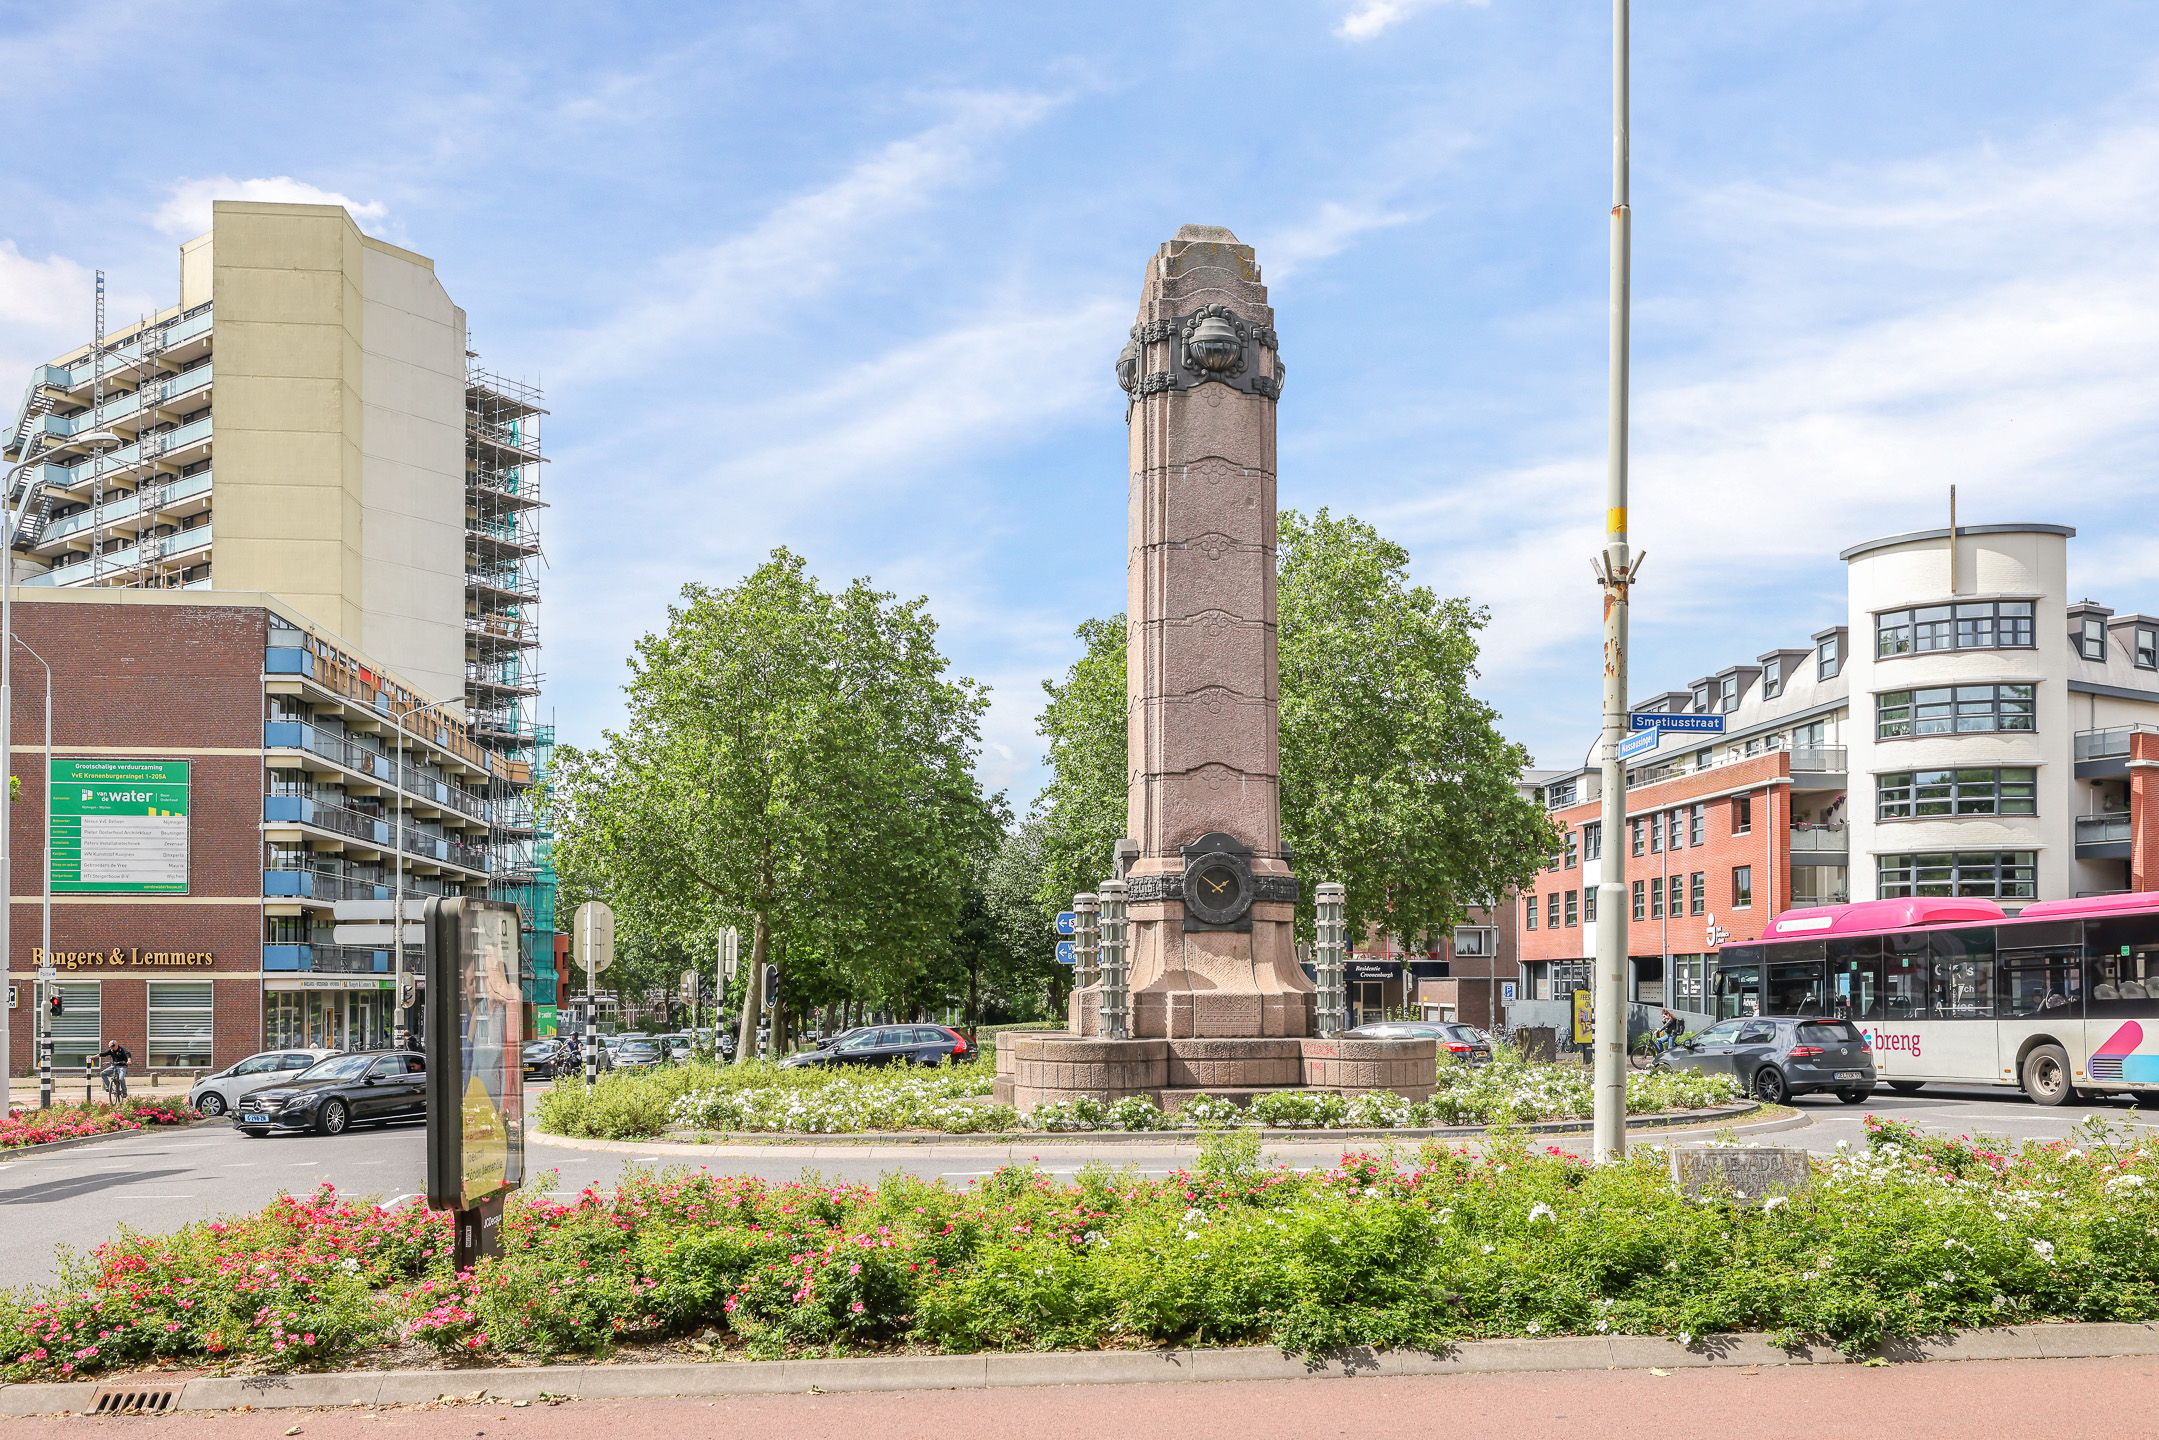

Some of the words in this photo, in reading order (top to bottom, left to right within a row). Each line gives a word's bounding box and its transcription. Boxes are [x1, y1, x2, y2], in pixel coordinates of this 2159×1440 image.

[1636, 716, 1720, 728] Smetiusstraat
[1621, 733, 1653, 754] Nassausingel
[75, 763, 117, 771] Grootschalige
[84, 772, 144, 780] Kronenburgersingel
[109, 790, 153, 802] water
[108, 947, 126, 966] &
[131, 947, 214, 966] Lemmers
[1874, 1028, 1921, 1057] breng
